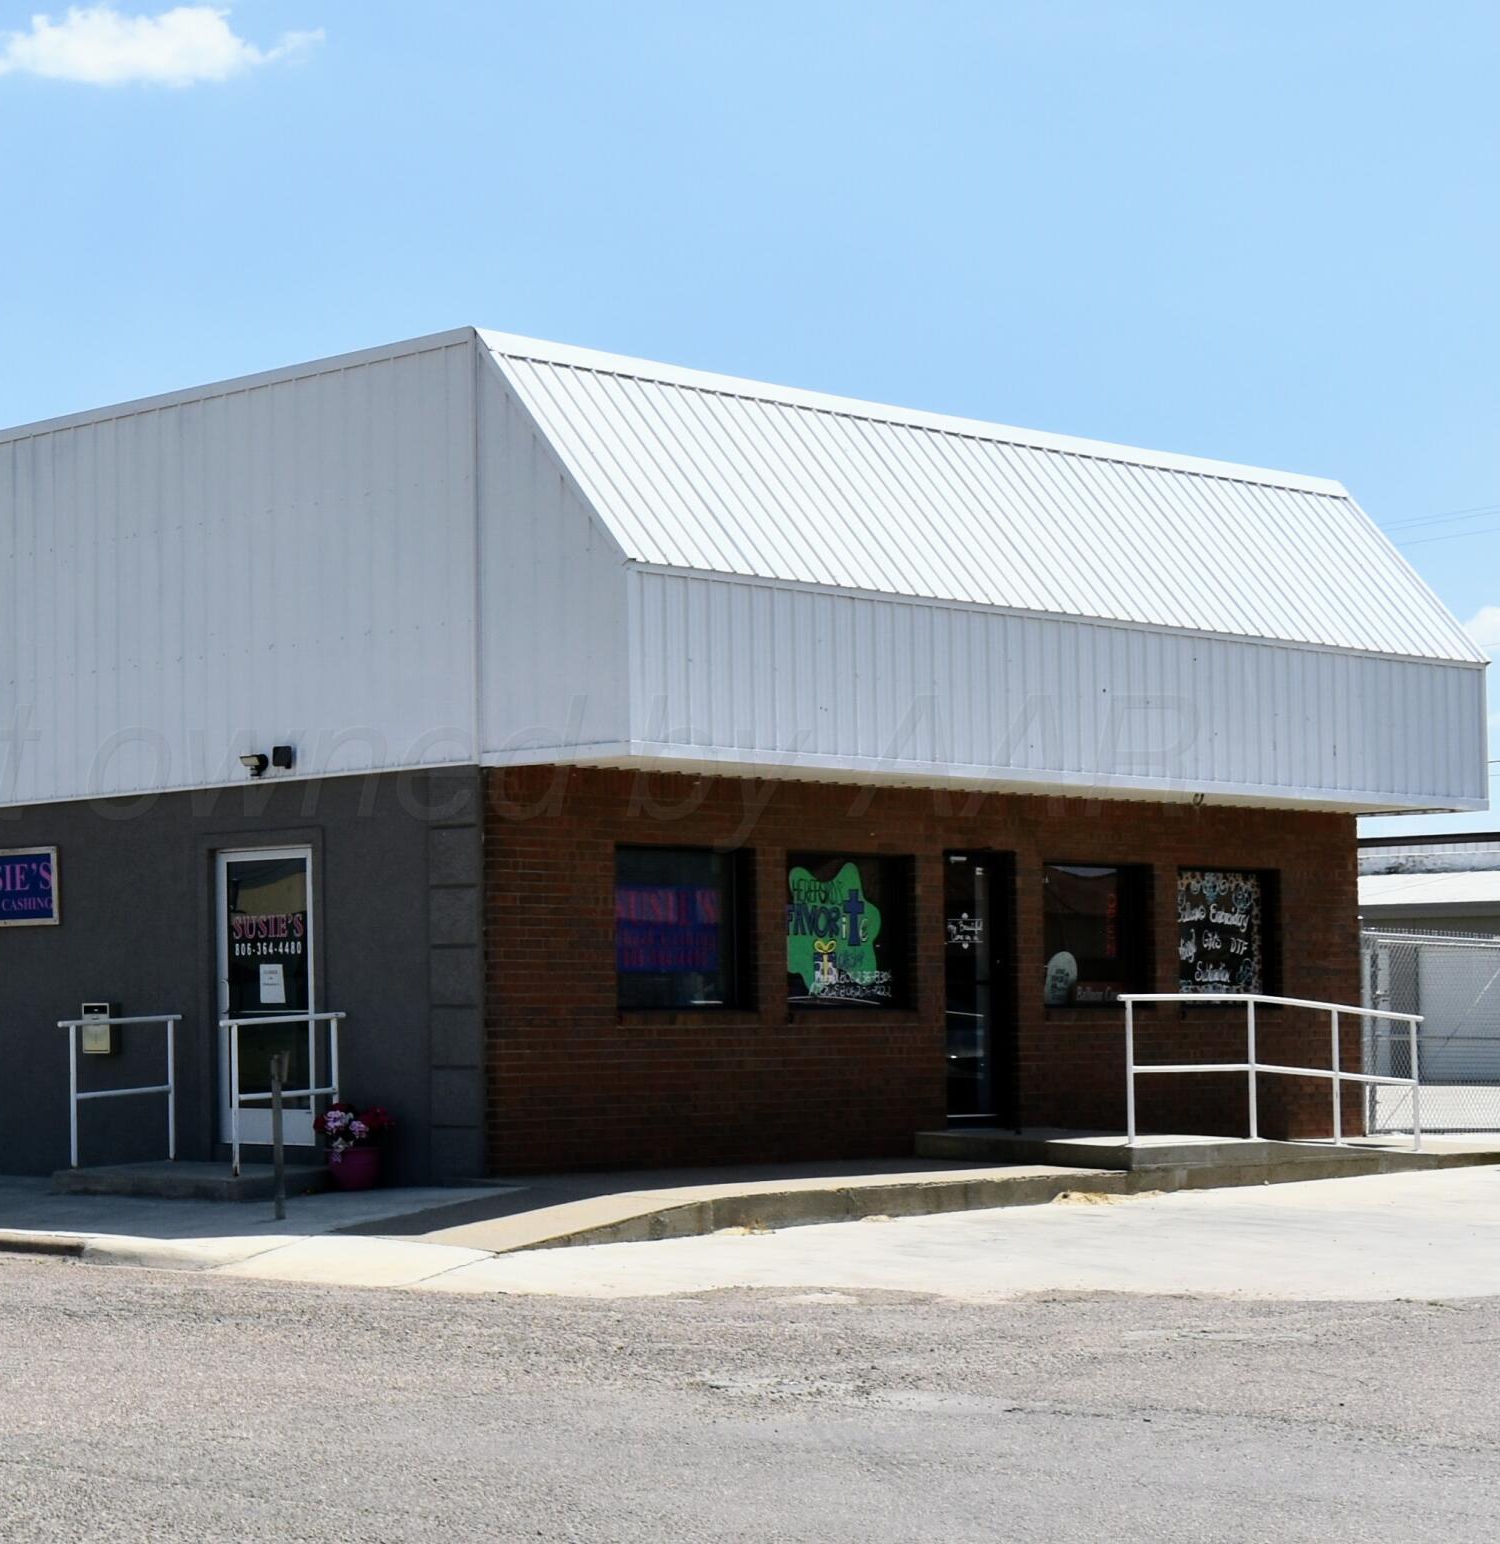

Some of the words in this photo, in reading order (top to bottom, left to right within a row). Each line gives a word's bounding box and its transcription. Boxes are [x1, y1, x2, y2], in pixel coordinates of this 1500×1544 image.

[2, 897, 53, 911] CASHING
[232, 913, 304, 939] SUSIE'S
[1230, 937, 1249, 955] DTF
